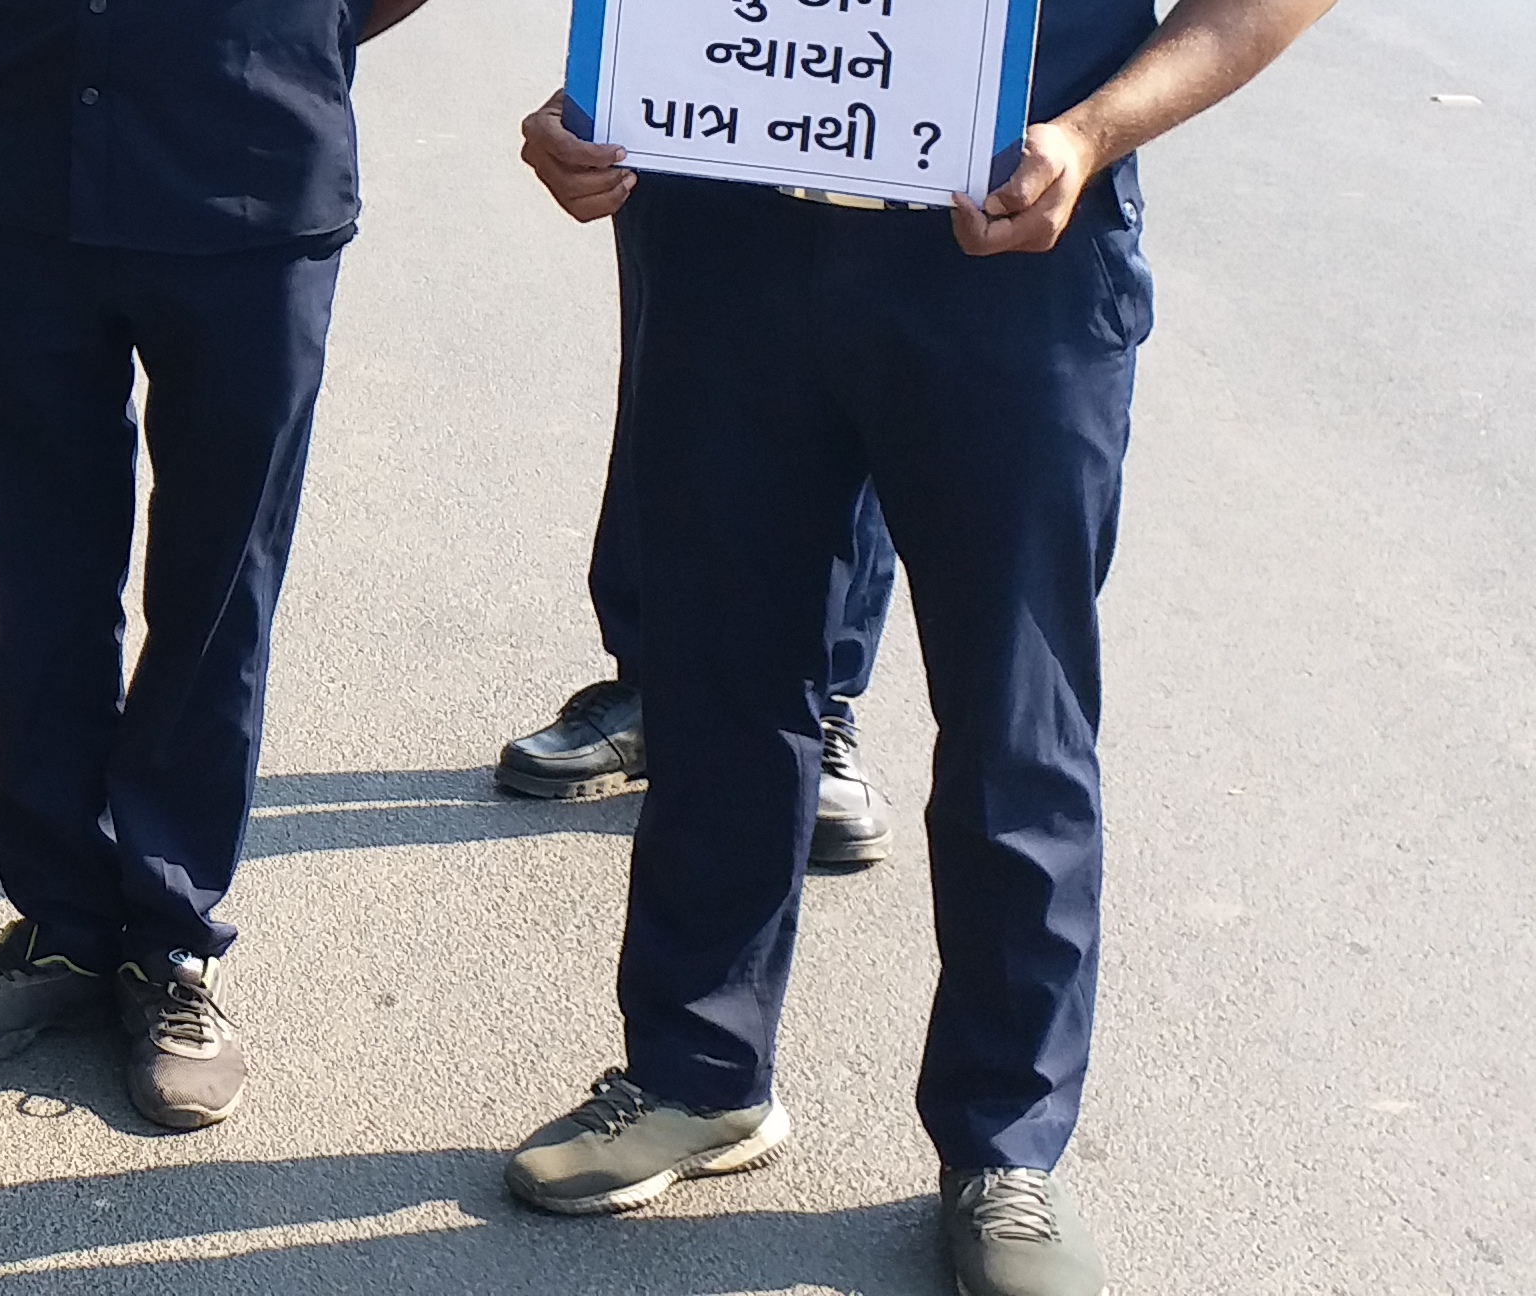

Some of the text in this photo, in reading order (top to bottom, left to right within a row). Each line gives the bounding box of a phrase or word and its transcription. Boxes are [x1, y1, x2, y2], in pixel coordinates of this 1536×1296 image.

[706, 31, 892, 89] ન્યાયને
[642, 98, 941, 169] પાત્ર નથી ?
